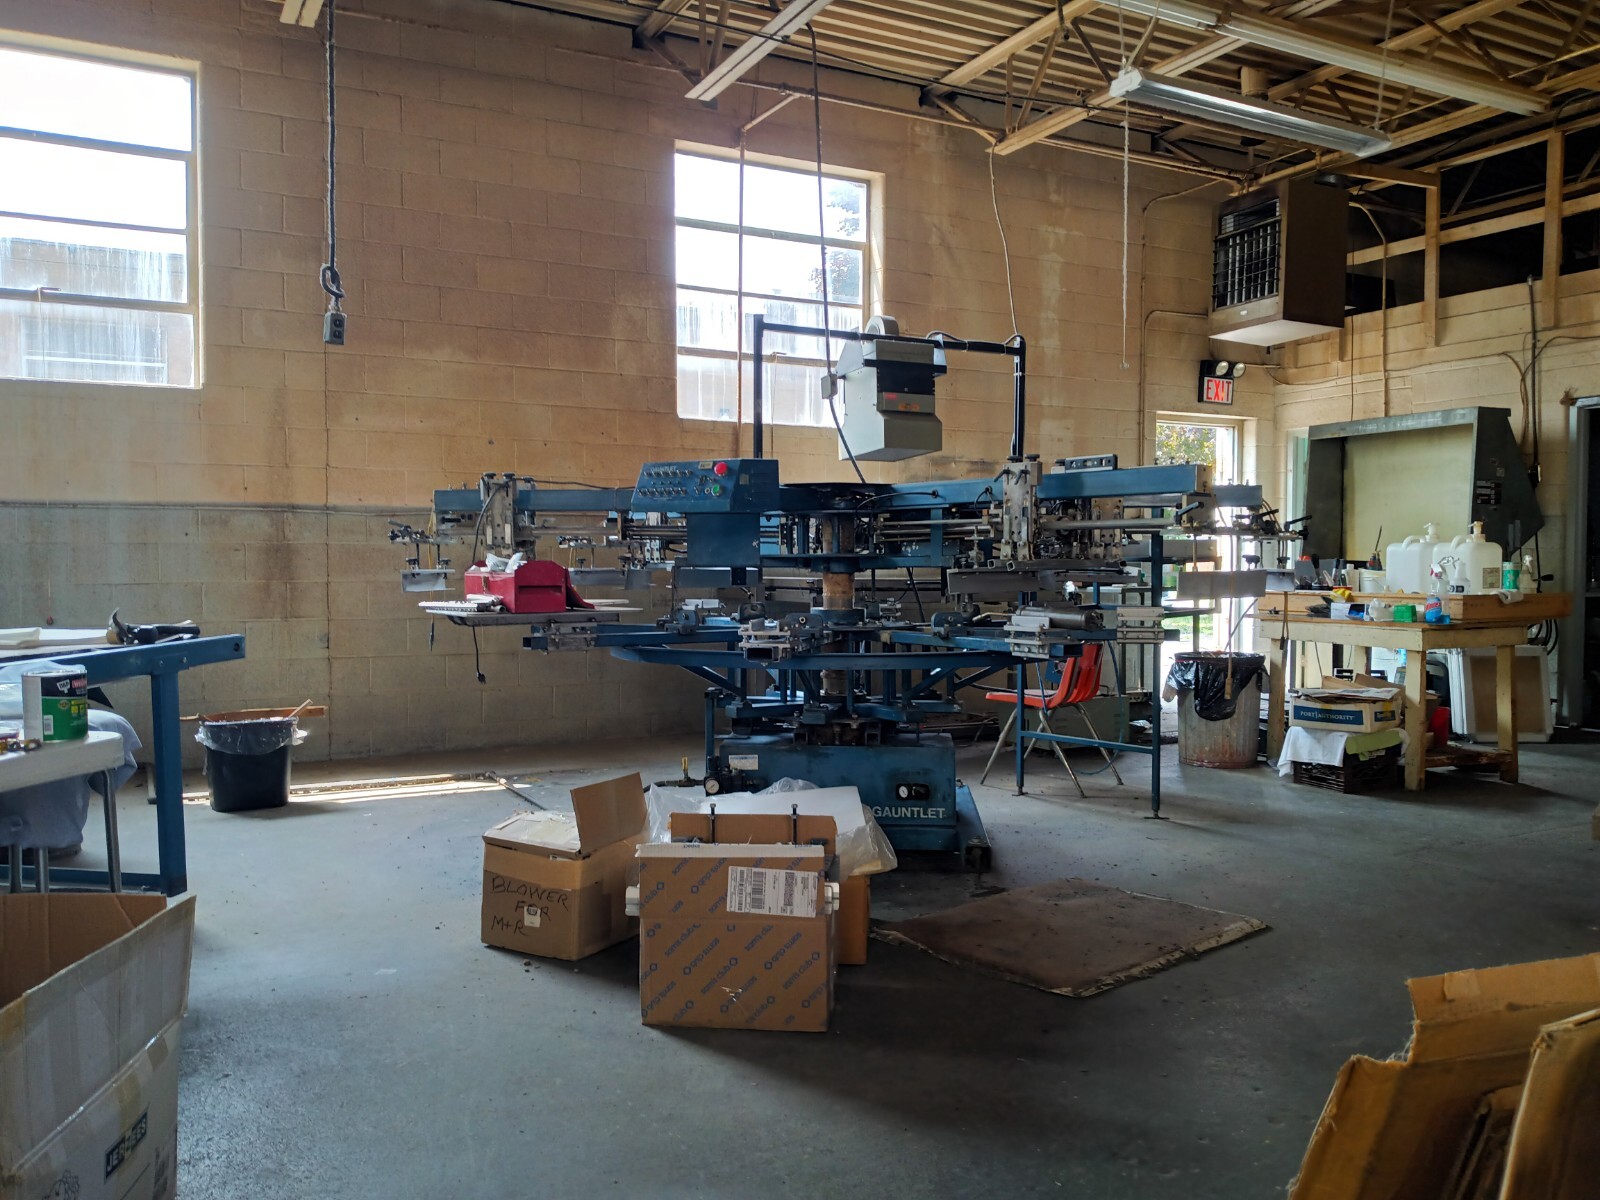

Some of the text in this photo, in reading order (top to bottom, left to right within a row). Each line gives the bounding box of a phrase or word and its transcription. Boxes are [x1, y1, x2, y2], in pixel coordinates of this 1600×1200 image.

[1206, 379, 1232, 402] EXIT
[872, 806, 946, 819] GAUNTLET
[492, 875, 569, 912] BLOWER
[515, 900, 552, 921] FOR
[491, 915, 530, 936] M+R
